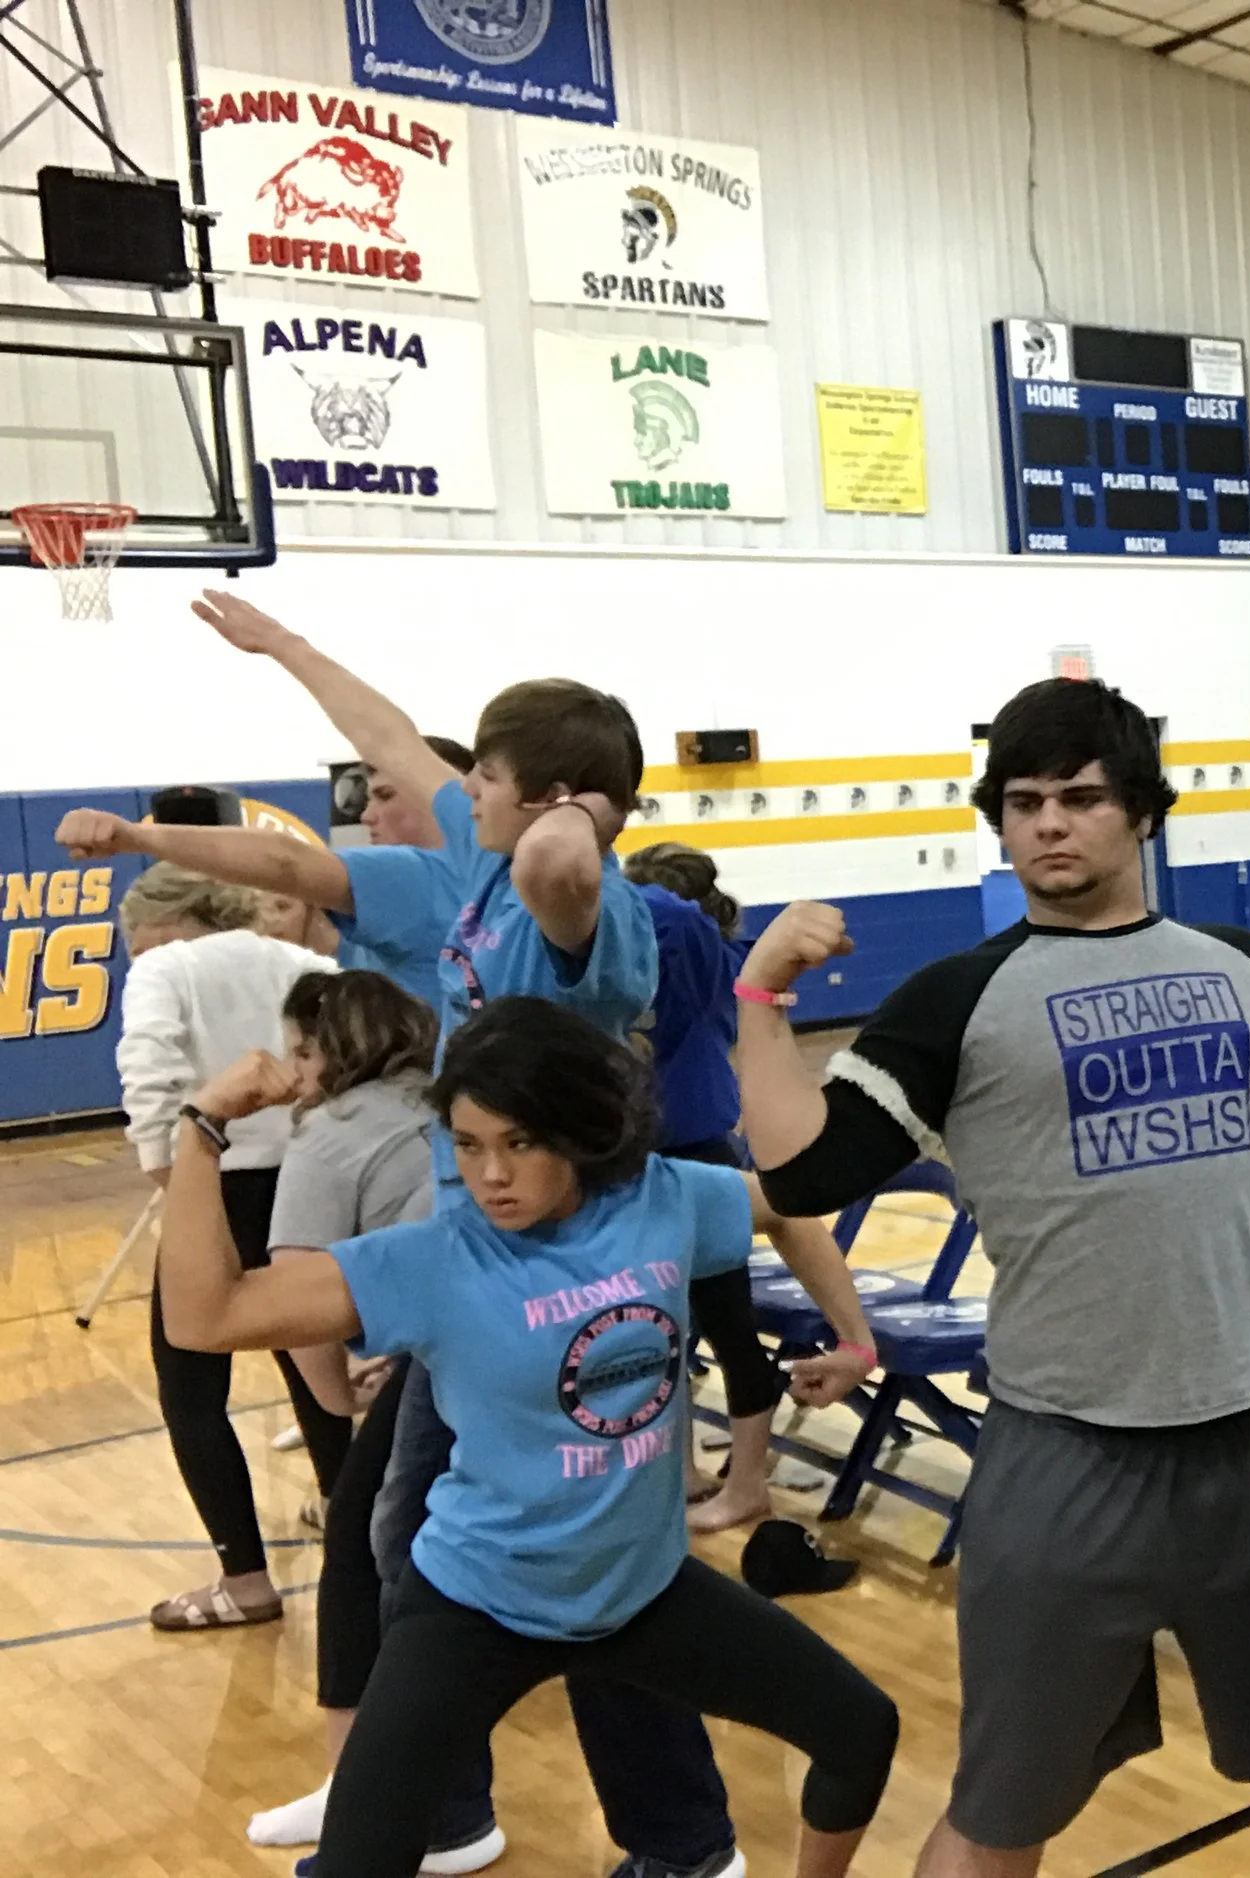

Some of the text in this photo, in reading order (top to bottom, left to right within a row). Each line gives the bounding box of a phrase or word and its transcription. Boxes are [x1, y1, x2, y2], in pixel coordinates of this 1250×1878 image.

[307, 93, 452, 166] VALLEY
[670, 152, 752, 210] SPRINGS
[248, 233, 422, 282] BUFFALOES
[583, 271, 725, 309] SPARTANS
[263, 318, 427, 369] ALPENA
[610, 345, 711, 388] LANE
[1026, 384, 1238, 420] HOME GUEST
[270, 458, 439, 496] WILDCATS
[610, 480, 731, 510] TROJANS
[1023, 468, 1064, 486] FOULS
[1102, 472, 1146, 490] PLAYER
[1213, 478, 1250, 495] FOULS
[1028, 533, 1068, 551] SCORE
[1124, 536, 1167, 552] MATCH
[1063, 980, 1228, 1042] STRAIGHT
[1079, 1032, 1243, 1103] OUTTA
[1086, 1096, 1246, 1165] WSHS
[523, 1268, 647, 1331] WELCOME
[644, 1261, 681, 1290] TO
[556, 1444, 612, 1478] THE
